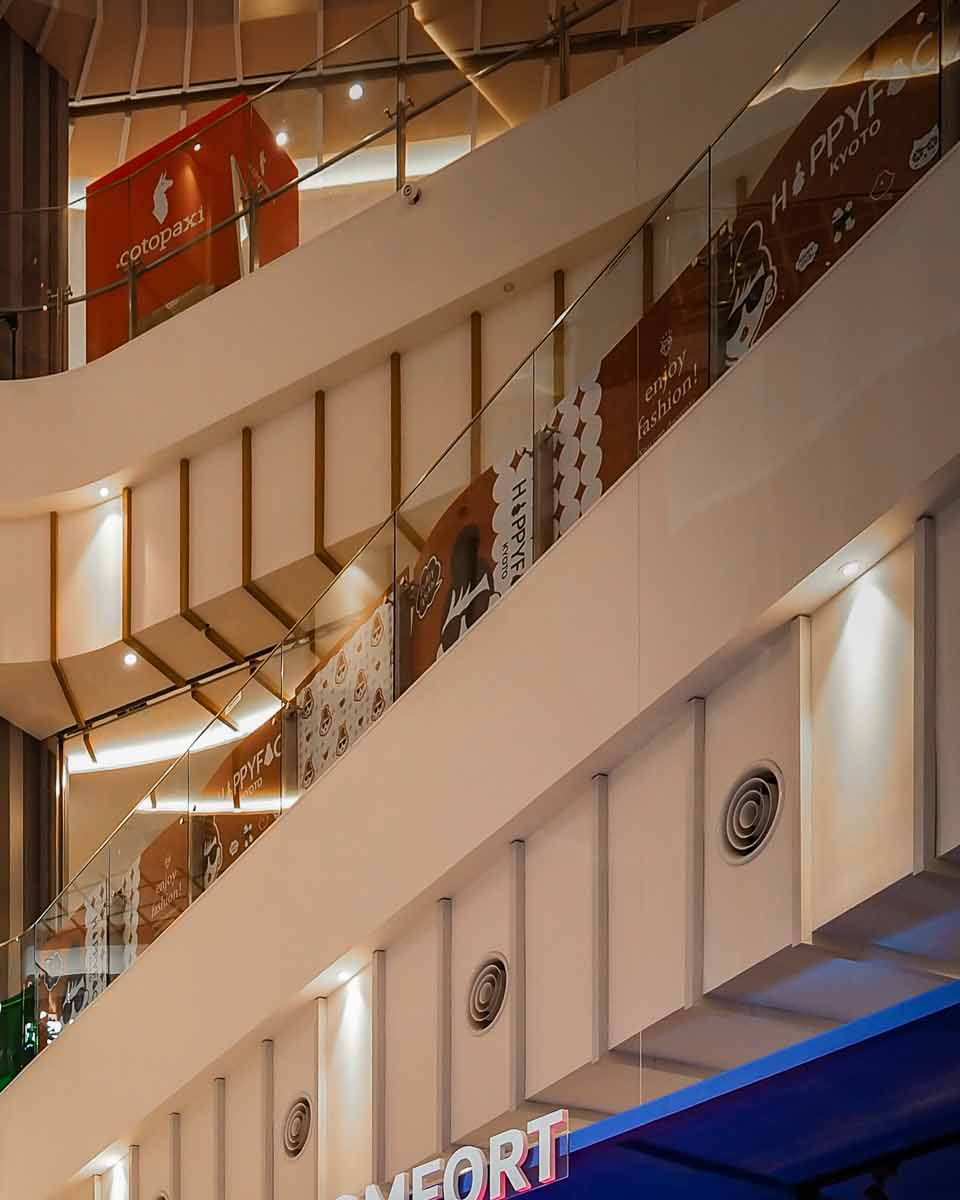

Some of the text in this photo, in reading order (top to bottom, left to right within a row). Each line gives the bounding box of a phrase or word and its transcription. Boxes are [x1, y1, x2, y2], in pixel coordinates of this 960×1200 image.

[828, 118, 882, 177] KYOTO
[638, 362, 698, 441] fashion!
[644, 348, 688, 402] enjoy
